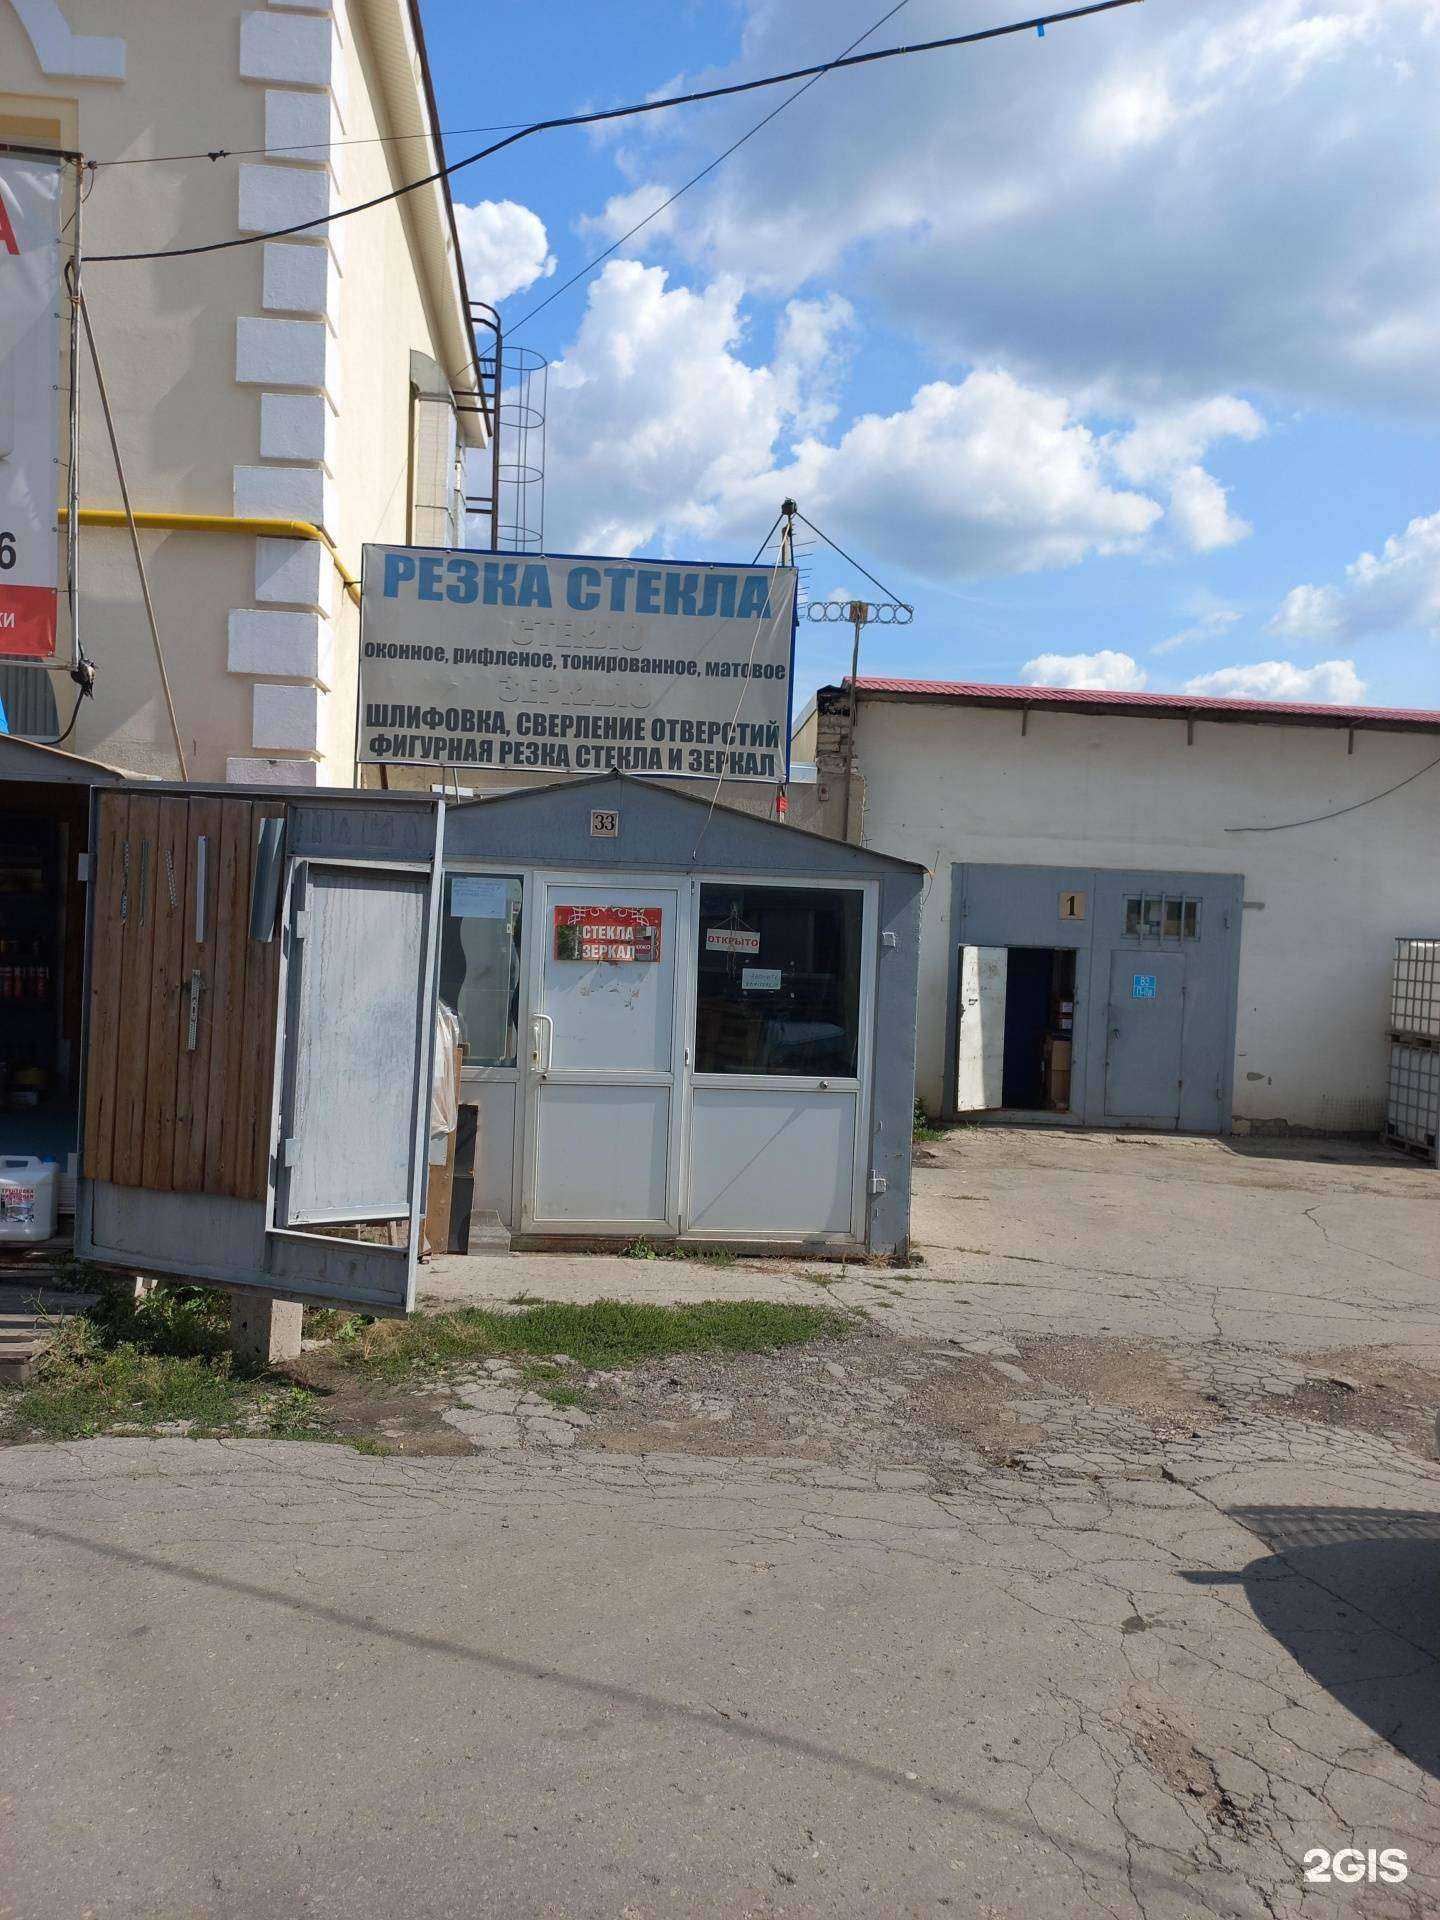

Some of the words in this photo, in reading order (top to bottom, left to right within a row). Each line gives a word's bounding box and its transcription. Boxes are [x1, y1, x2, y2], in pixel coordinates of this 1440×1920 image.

[384, 553, 552, 608] РЕЗКА
[566, 567, 772, 619] СТЕКЛА
[364, 641, 449, 665] оконное,
[453, 645, 557, 671] рифленое,
[561, 654, 701, 678] тонированное,
[705, 661, 786, 681] матовое
[366, 703, 511, 738] ШЛИФОВКА,
[516, 712, 646, 742] СВЕРЛЕНИЕ
[651, 718, 780, 749] ОТВЕРСТИЙ
[369, 733, 494, 764] ФИГУРНАЯ
[499, 740, 571, 768] РЕЗКА
[575, 744, 663, 771] СТЕКЛА
[668, 748, 683, 771] И
[688, 750, 775, 777] ЗЕРКАЛ
[594, 814, 615, 831] 33
[1066, 896, 1077, 916] 1
[582, 925, 633, 941] СТЕКЛА
[707, 935, 759, 947] ОТКРЫТО
[582, 944, 635, 960] ЗЕРКАЛ
